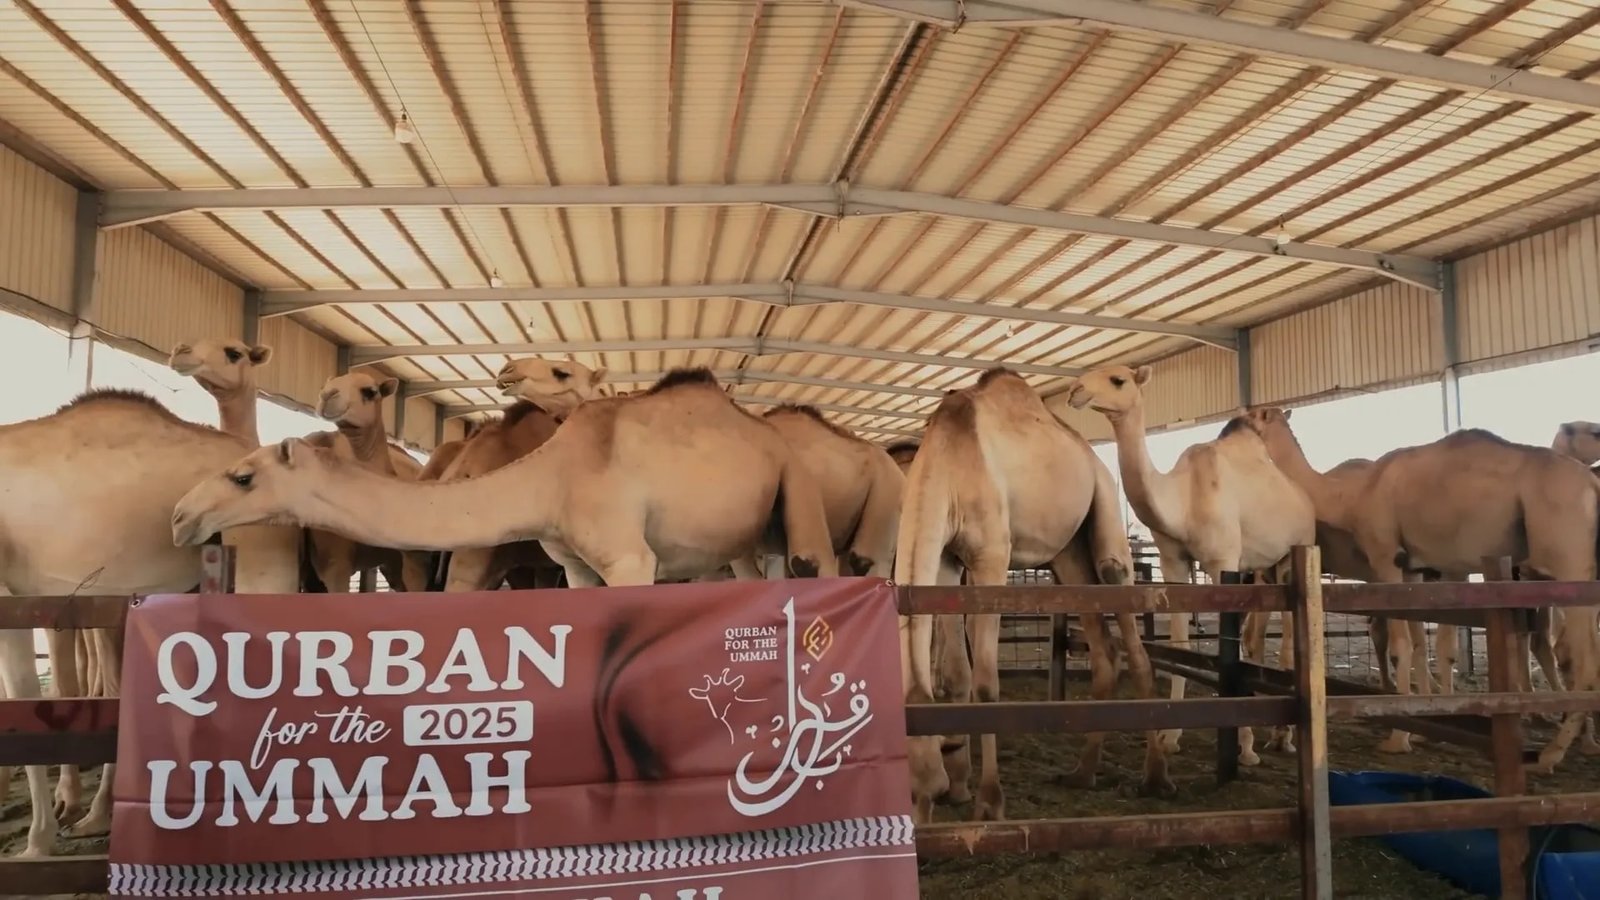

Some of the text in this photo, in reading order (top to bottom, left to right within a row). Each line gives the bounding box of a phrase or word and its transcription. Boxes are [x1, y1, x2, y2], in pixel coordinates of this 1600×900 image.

[724, 625, 777, 640] QURBAN
[724, 637, 778, 650] FOR THE
[156, 624, 574, 717] QURBAN
[730, 650, 778, 662] UMMAH
[250, 705, 517, 770] for the 2025
[146, 749, 532, 831] UMMAH
